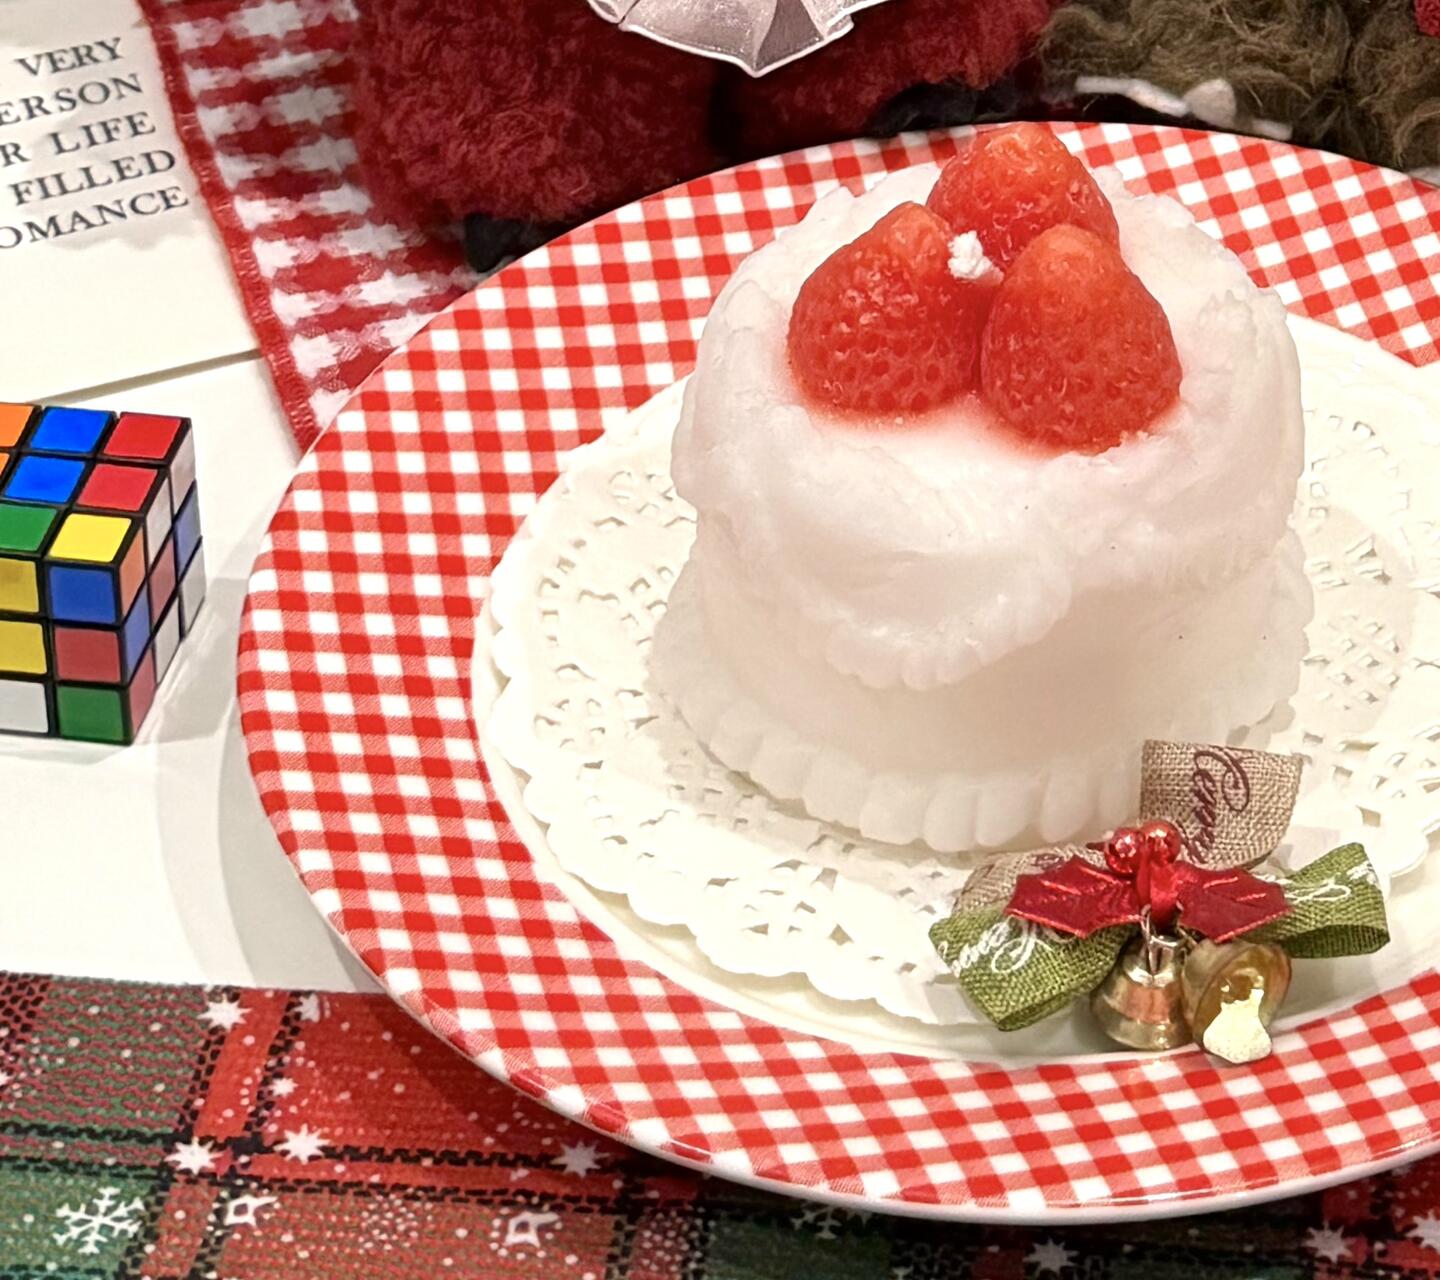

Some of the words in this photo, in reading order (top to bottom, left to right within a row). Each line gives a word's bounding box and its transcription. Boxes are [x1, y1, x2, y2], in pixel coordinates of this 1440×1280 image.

[13, 37, 122, 77] VERY
[49, 111, 156, 156] LIFE
[8, 149, 177, 207] FILLED
